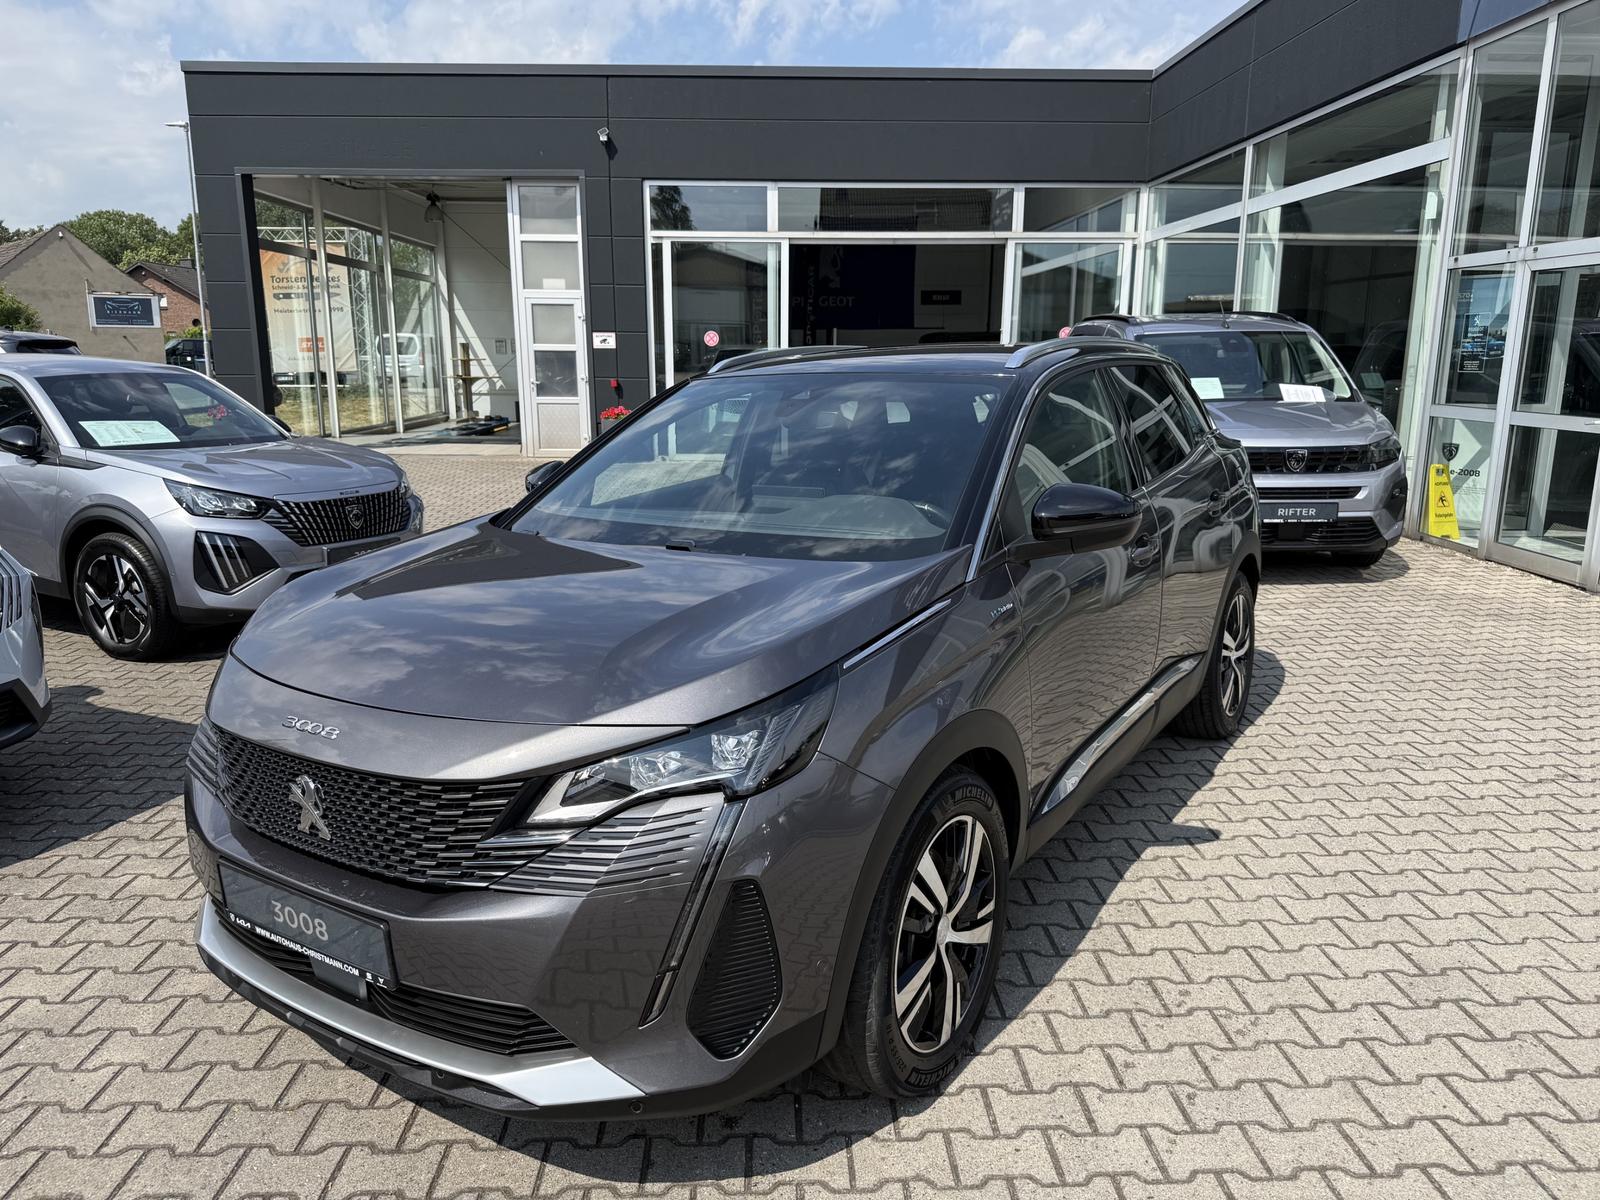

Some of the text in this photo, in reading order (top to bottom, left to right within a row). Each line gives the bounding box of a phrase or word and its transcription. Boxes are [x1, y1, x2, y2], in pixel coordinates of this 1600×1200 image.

[270, 275, 306, 284] Torsten
[1450, 468, 1481, 477] e-2008
[1277, 508, 1317, 516] RIFTER
[281, 715, 341, 740] 3008
[954, 784, 994, 808] MICHELIN
[271, 900, 329, 941] 3008
[255, 926, 360, 977] WWW.AUTOHAUS-CHRISTMANN.COM
